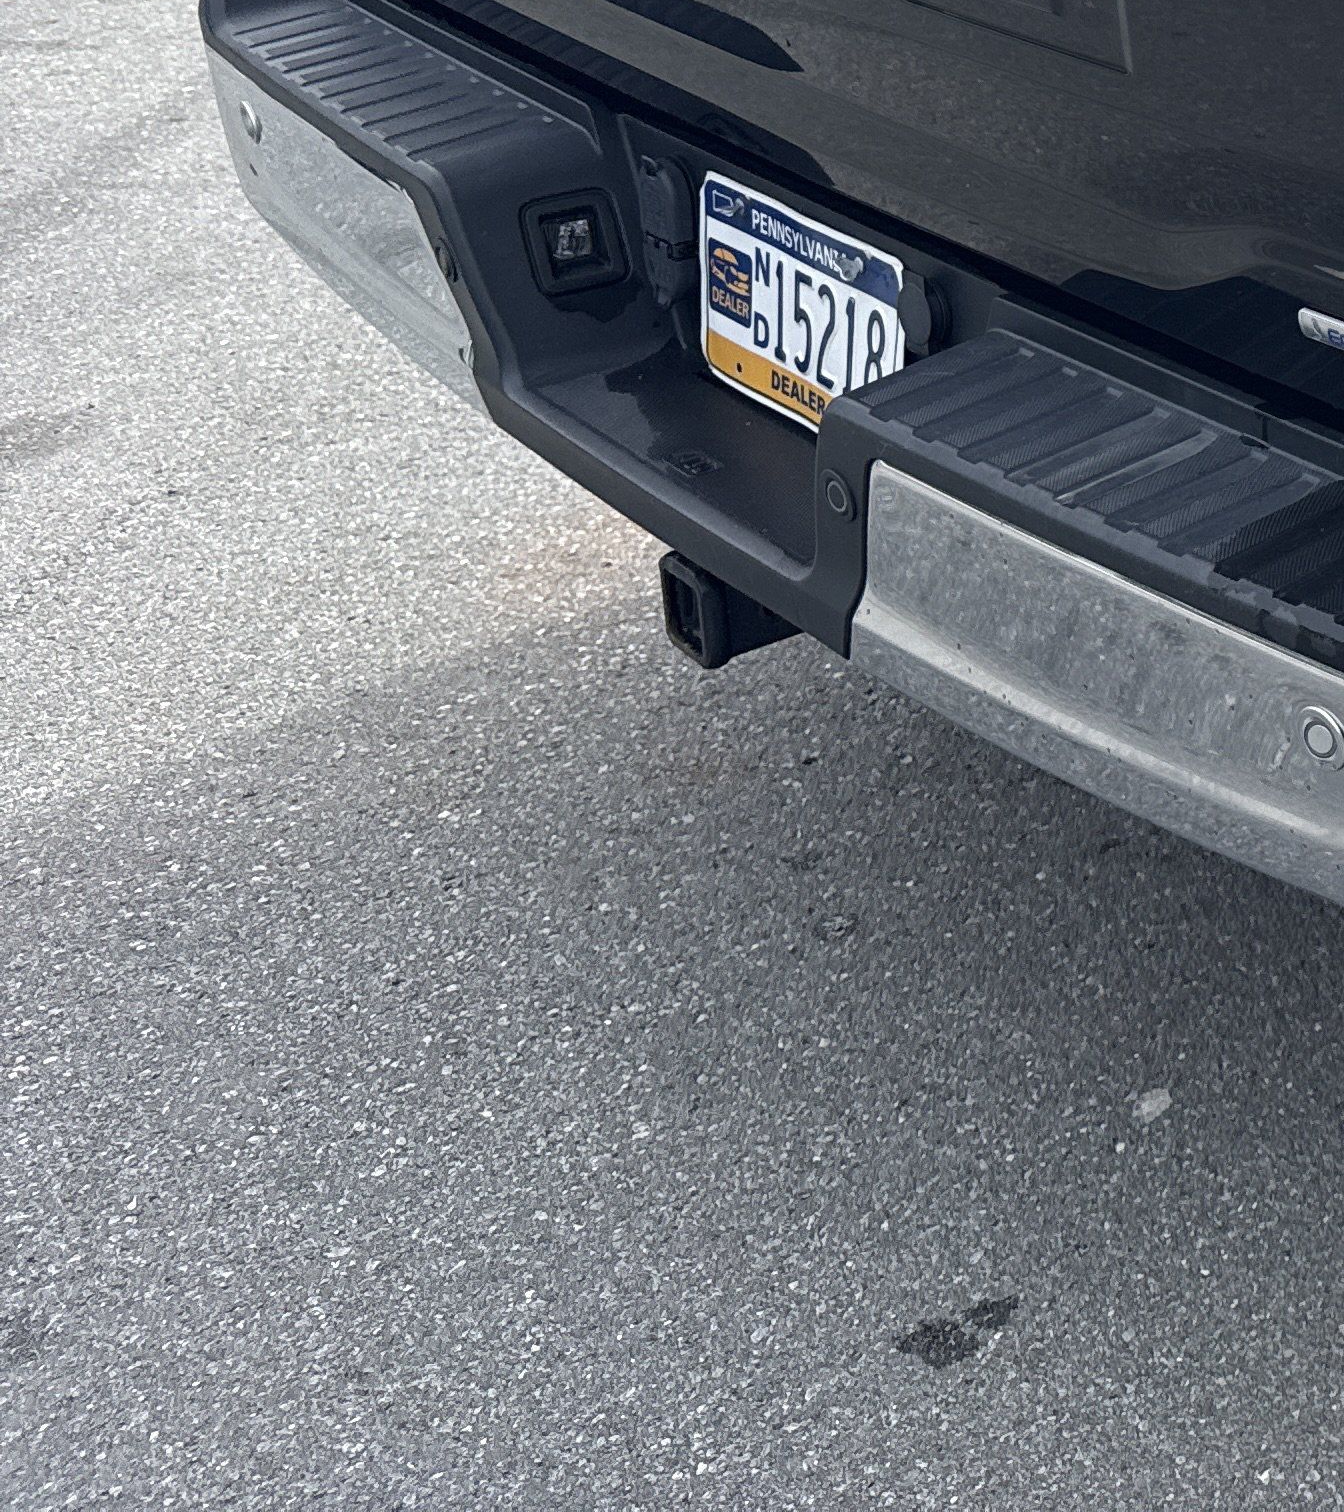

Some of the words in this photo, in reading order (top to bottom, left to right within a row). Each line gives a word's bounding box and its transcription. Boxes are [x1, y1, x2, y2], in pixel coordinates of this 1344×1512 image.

[751, 208, 850, 273] PENNSYLVANI
[711, 285, 750, 320] DEALER
[774, 259, 887, 395] 15218
[771, 368, 826, 416] DEALER
